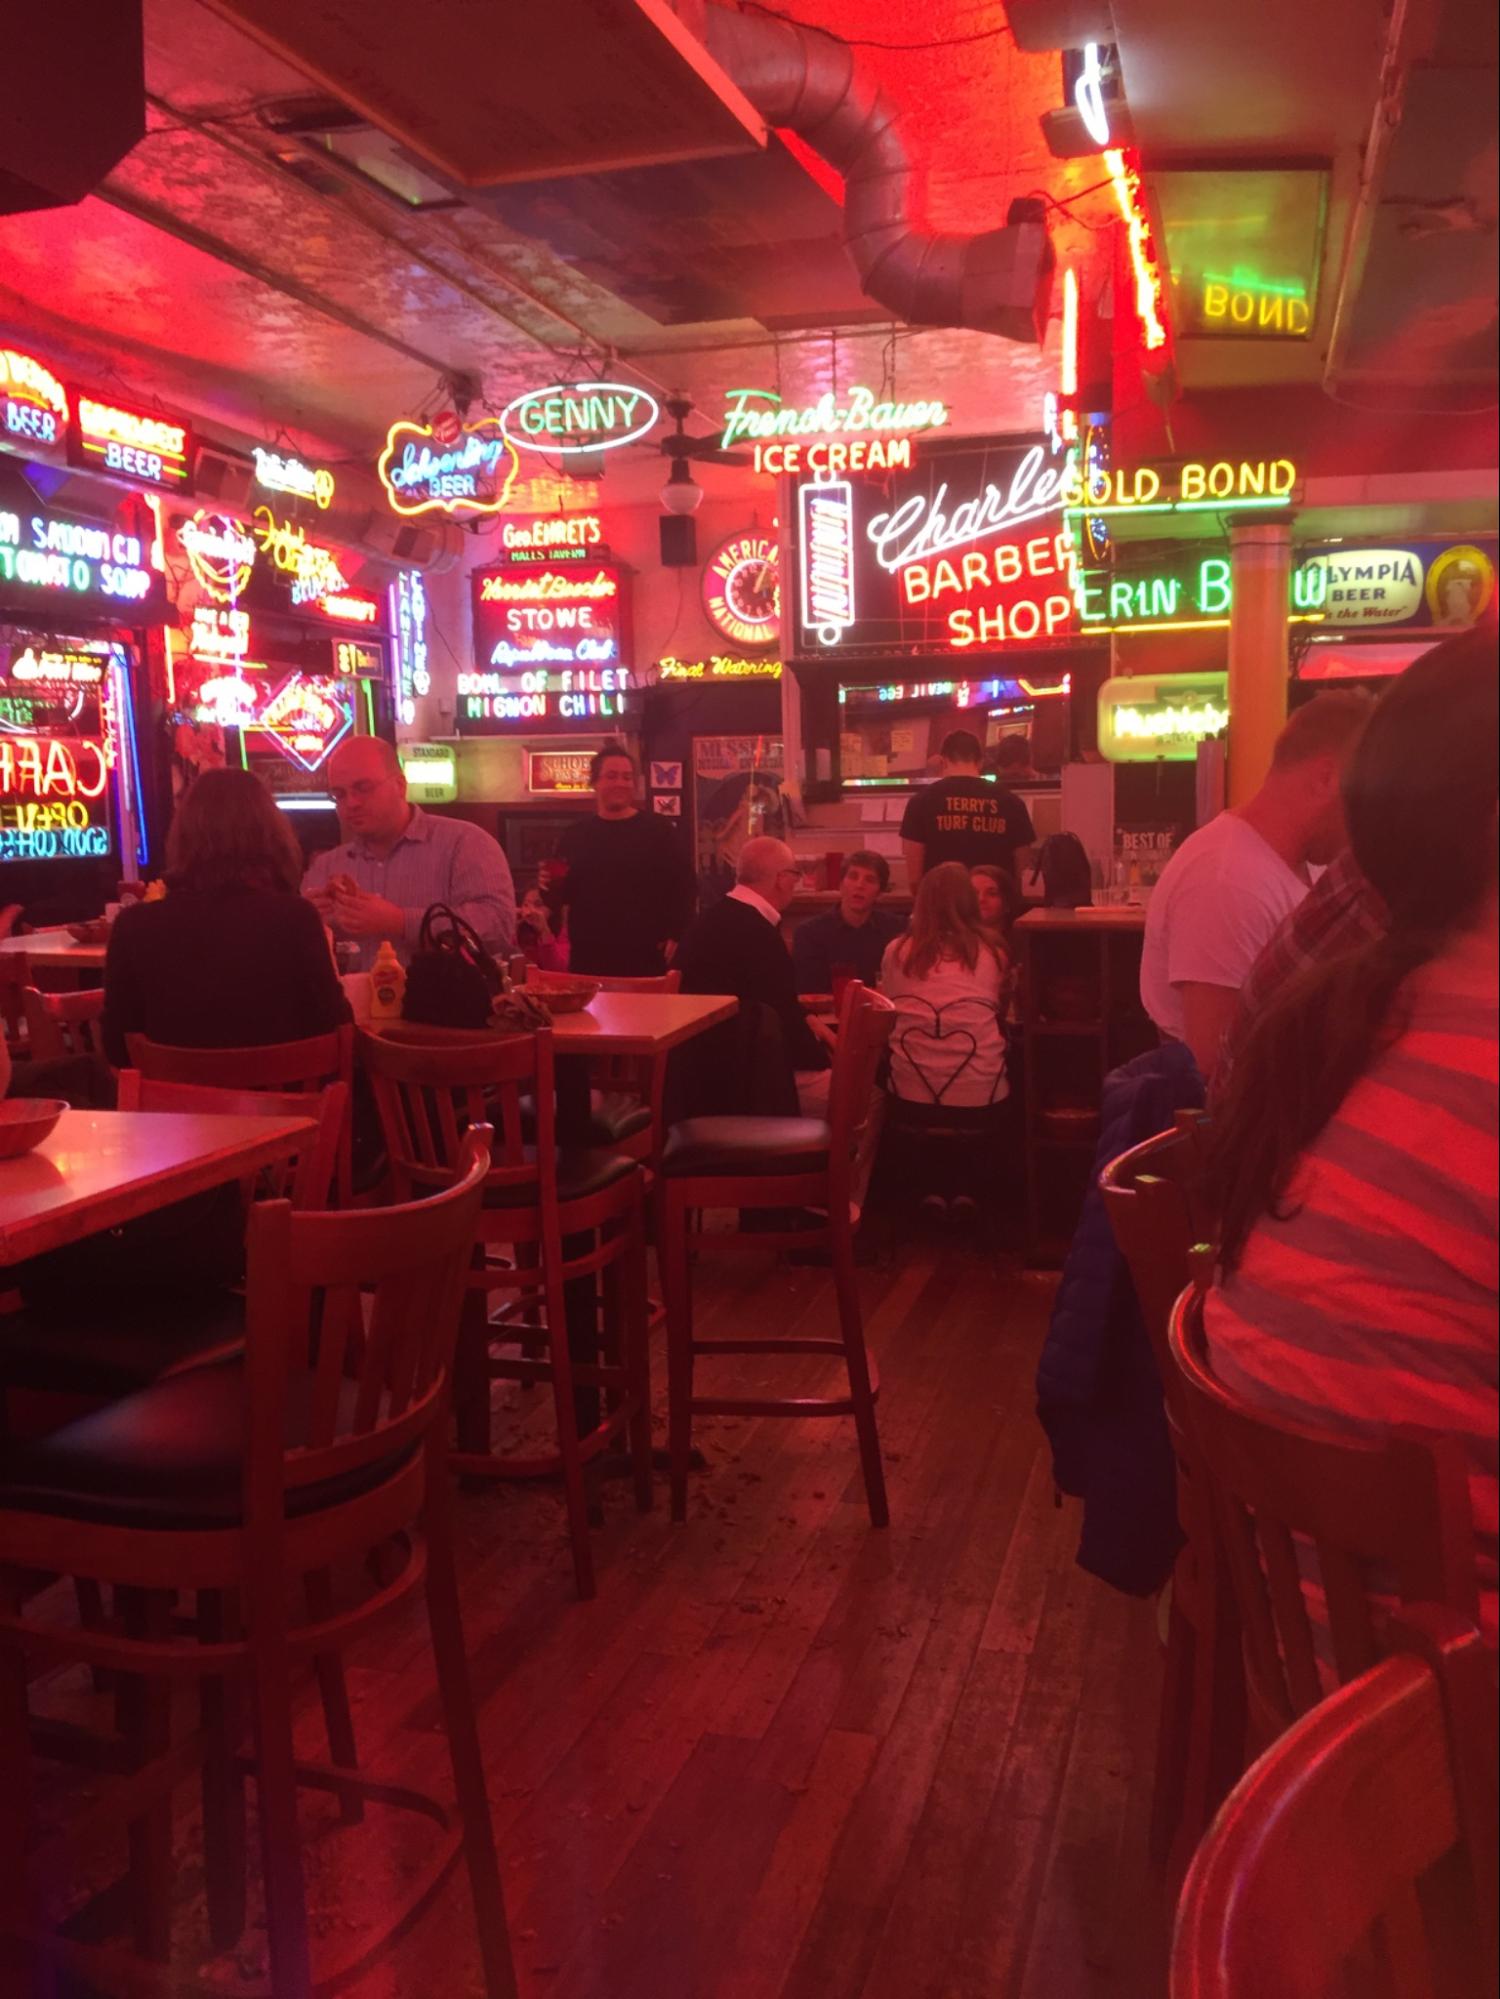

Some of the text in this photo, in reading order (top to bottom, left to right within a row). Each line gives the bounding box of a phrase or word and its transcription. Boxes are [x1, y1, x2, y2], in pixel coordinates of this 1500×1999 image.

[7, 401, 56, 442] BEER
[519, 395, 639, 435] GENNY
[105, 442, 162, 481] BEER
[754, 438, 911, 473] ICE CREAM
[430, 474, 477, 497] BEER
[1061, 459, 1296, 506] GOLD BOND
[712, 539, 780, 581] AMERICA
[904, 533, 1077, 604] BARBER
[1308, 558, 1417, 587] LYMPIA
[1331, 587, 1387, 602] BEER
[506, 606, 593, 631] STOWE
[709, 596, 776, 642] NATIONAL
[948, 595, 1071, 648] SHOP
[520, 670, 548, 693] OF
[561, 668, 629, 692] FILET
[558, 692, 624, 717] CHILI
[945, 796, 999, 815] TERRY'S
[936, 815, 1006, 833] TURF CLUB
[1122, 831, 1175, 849] BEST OF
